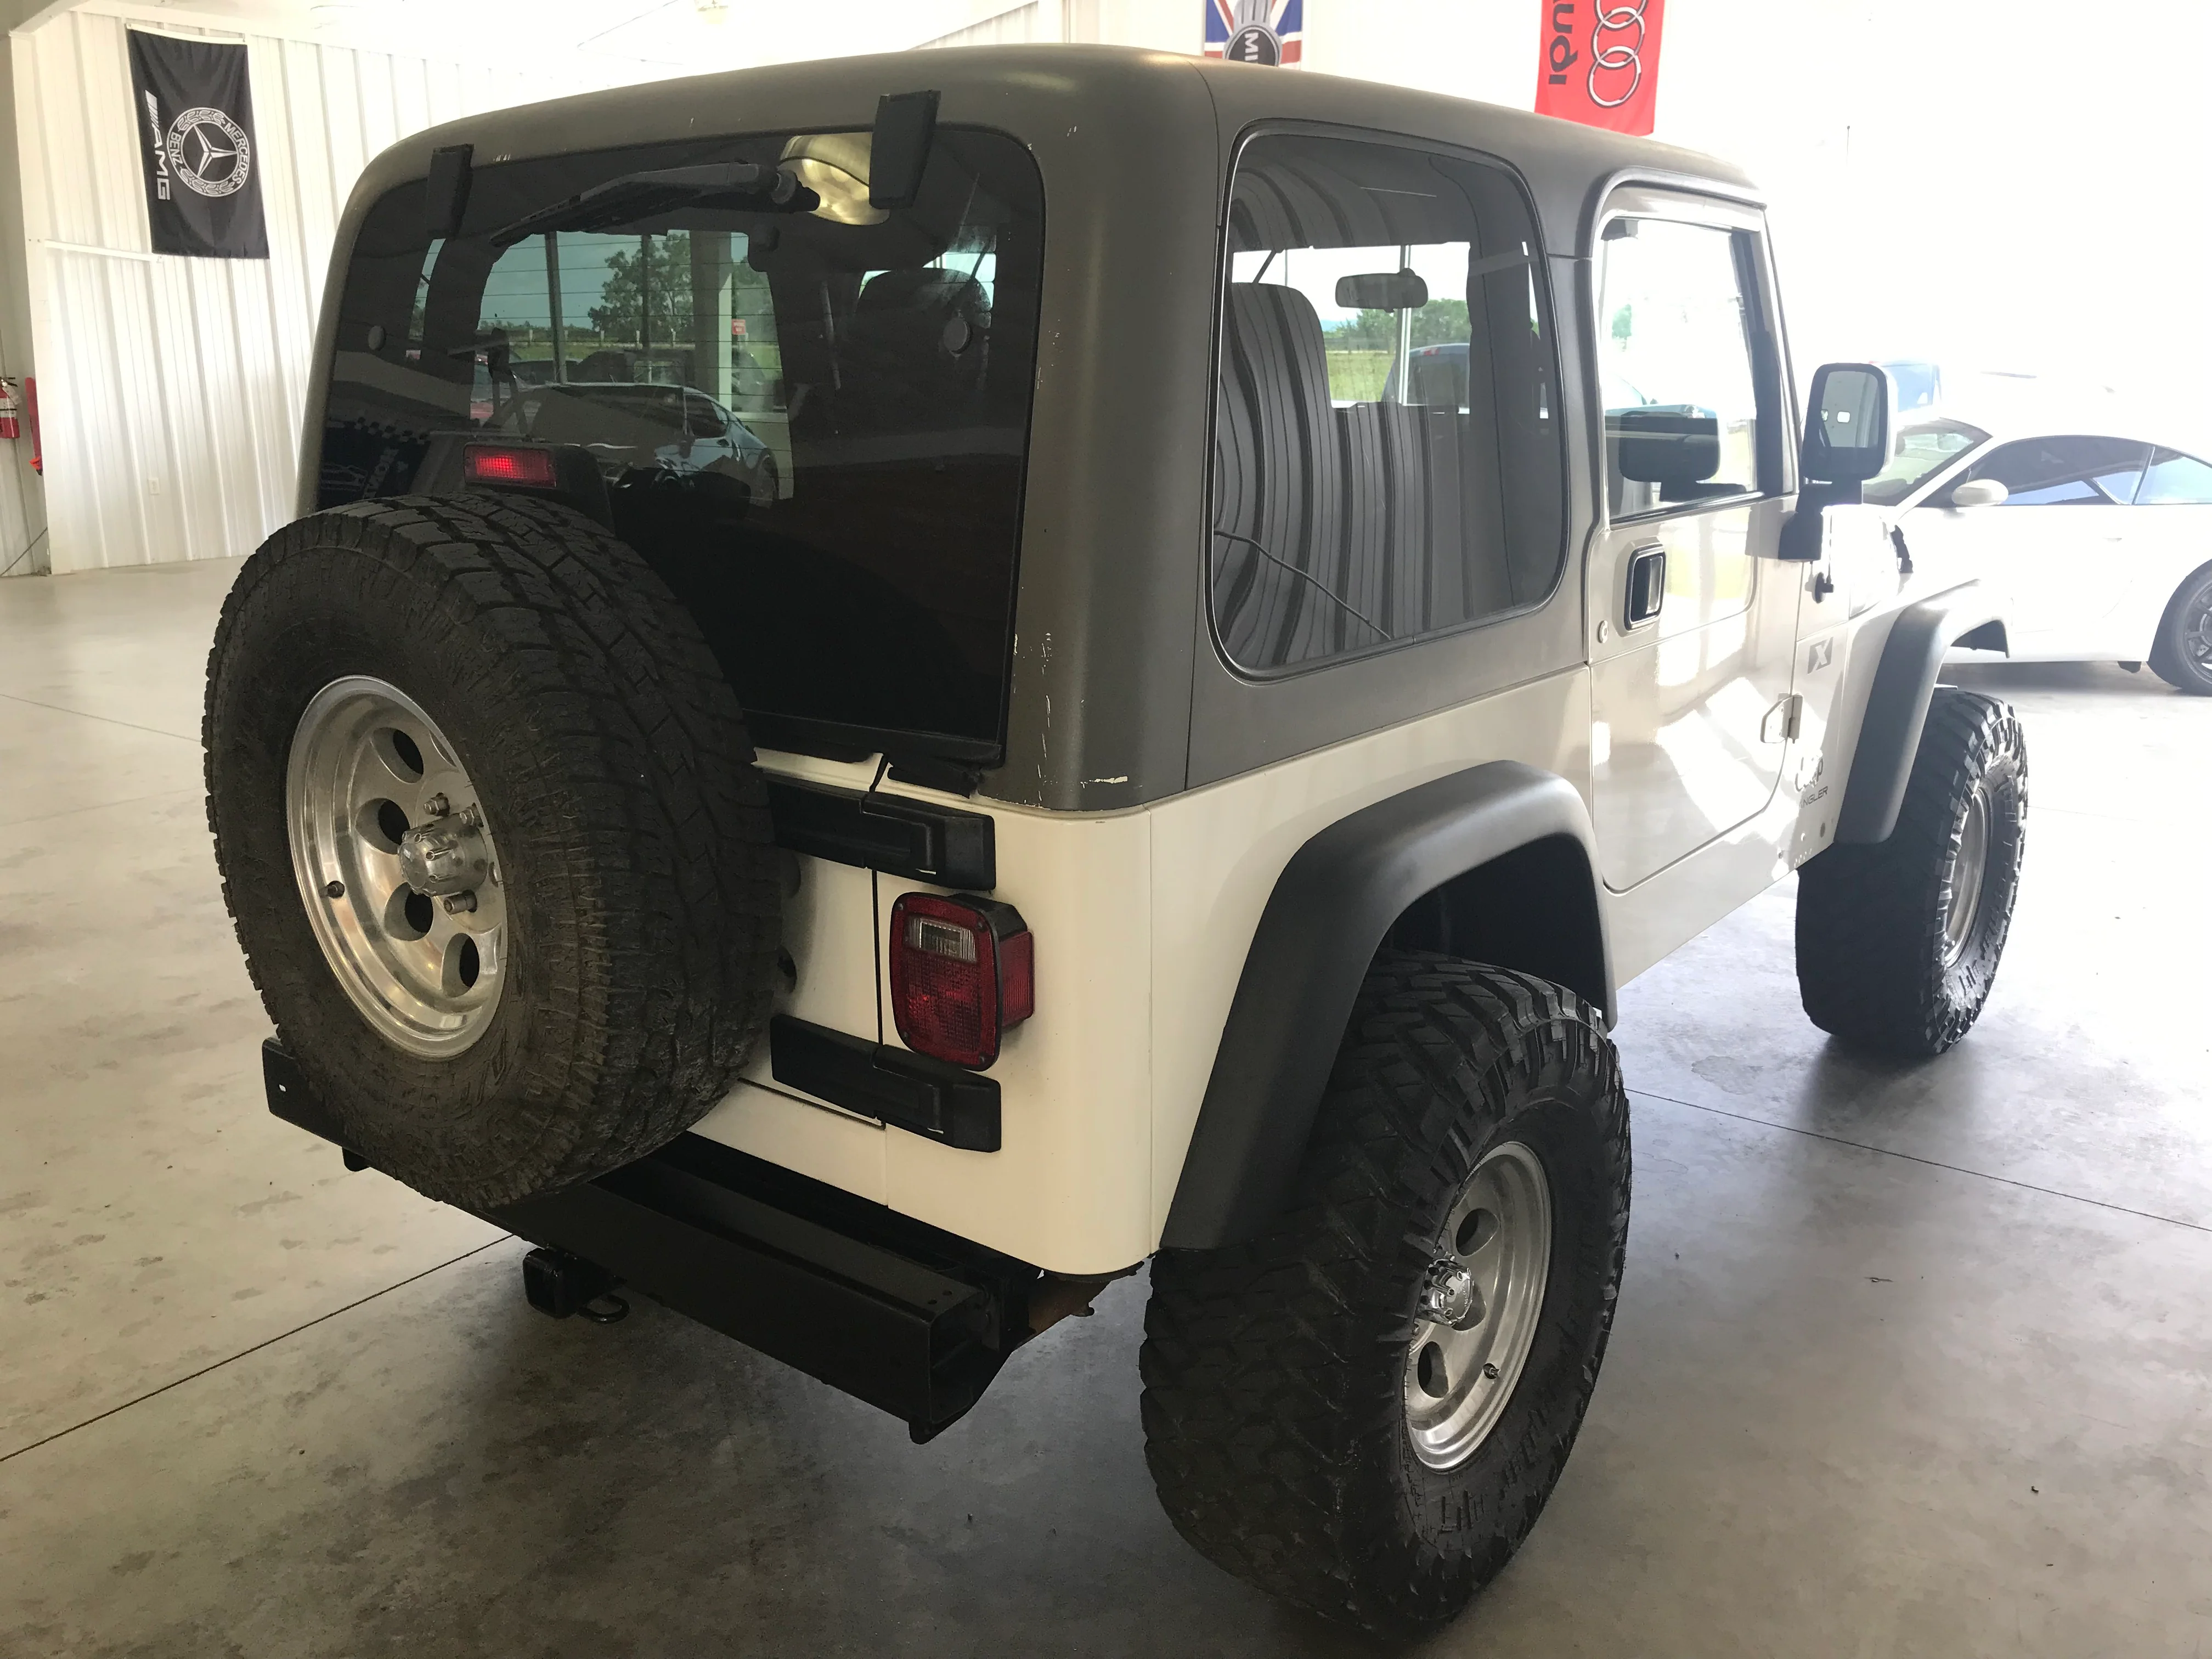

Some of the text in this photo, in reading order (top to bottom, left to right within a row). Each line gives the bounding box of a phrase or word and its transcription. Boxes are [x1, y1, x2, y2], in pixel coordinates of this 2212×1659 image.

[1244, 32, 1259, 62] MI
[1548, 0, 1578, 85] udi
[151, 122, 171, 200] AMG
[169, 131, 184, 166] BENZ
[224, 122, 248, 184] MERCEDES
[1799, 786, 1828, 809] NGLER
